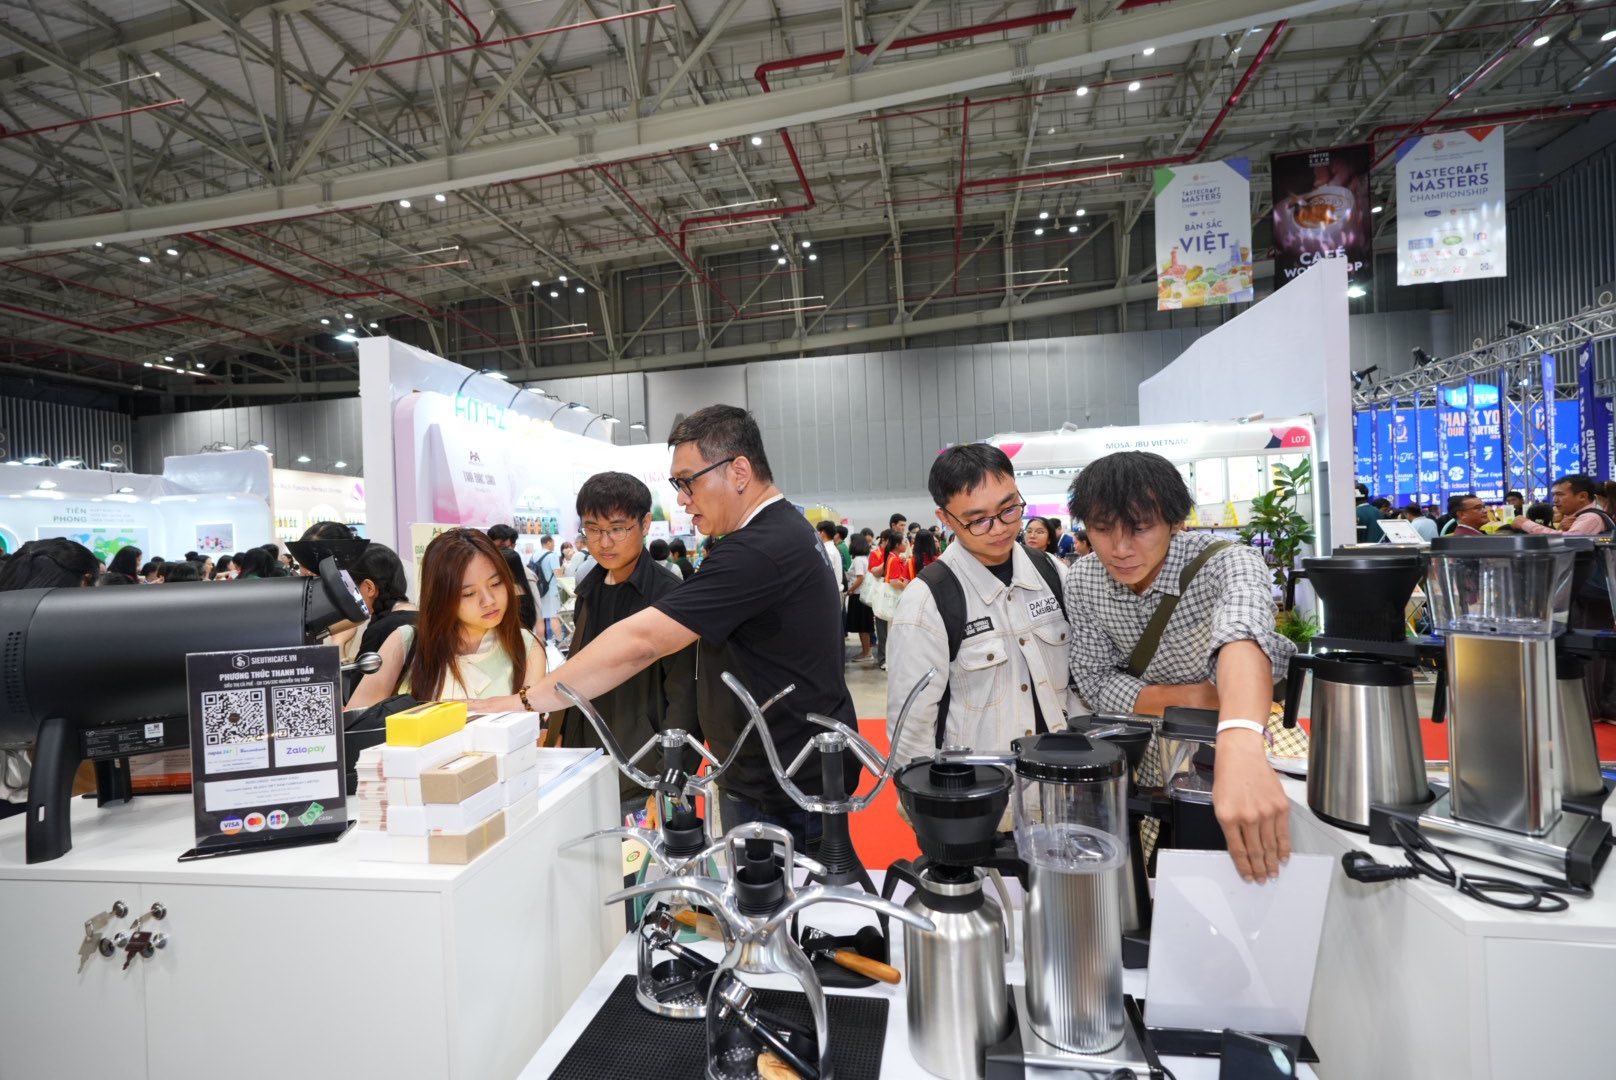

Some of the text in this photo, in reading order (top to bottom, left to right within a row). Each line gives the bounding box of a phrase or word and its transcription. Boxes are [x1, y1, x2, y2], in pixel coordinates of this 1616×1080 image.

[1409, 162, 1488, 180] TASTECRAFT
[1410, 173, 1489, 193] MASTERS
[1183, 187, 1221, 196] TASTECRAFT
[1410, 187, 1488, 203] CHAMPIONSHIP
[1182, 193, 1221, 203] MASTERS
[1179, 230, 1229, 254] VIỆT
[1151, 438, 1189, 447] VIETNAM
[1291, 436, 1307, 444] L07
[53, 515, 88, 523] PHONG
[251, 654, 297, 665] SIEUTHICAFE.VN
[219, 665, 315, 681] PHƯƠNG THỨC THANH TOÁN
[224, 821, 240, 829] VISA
